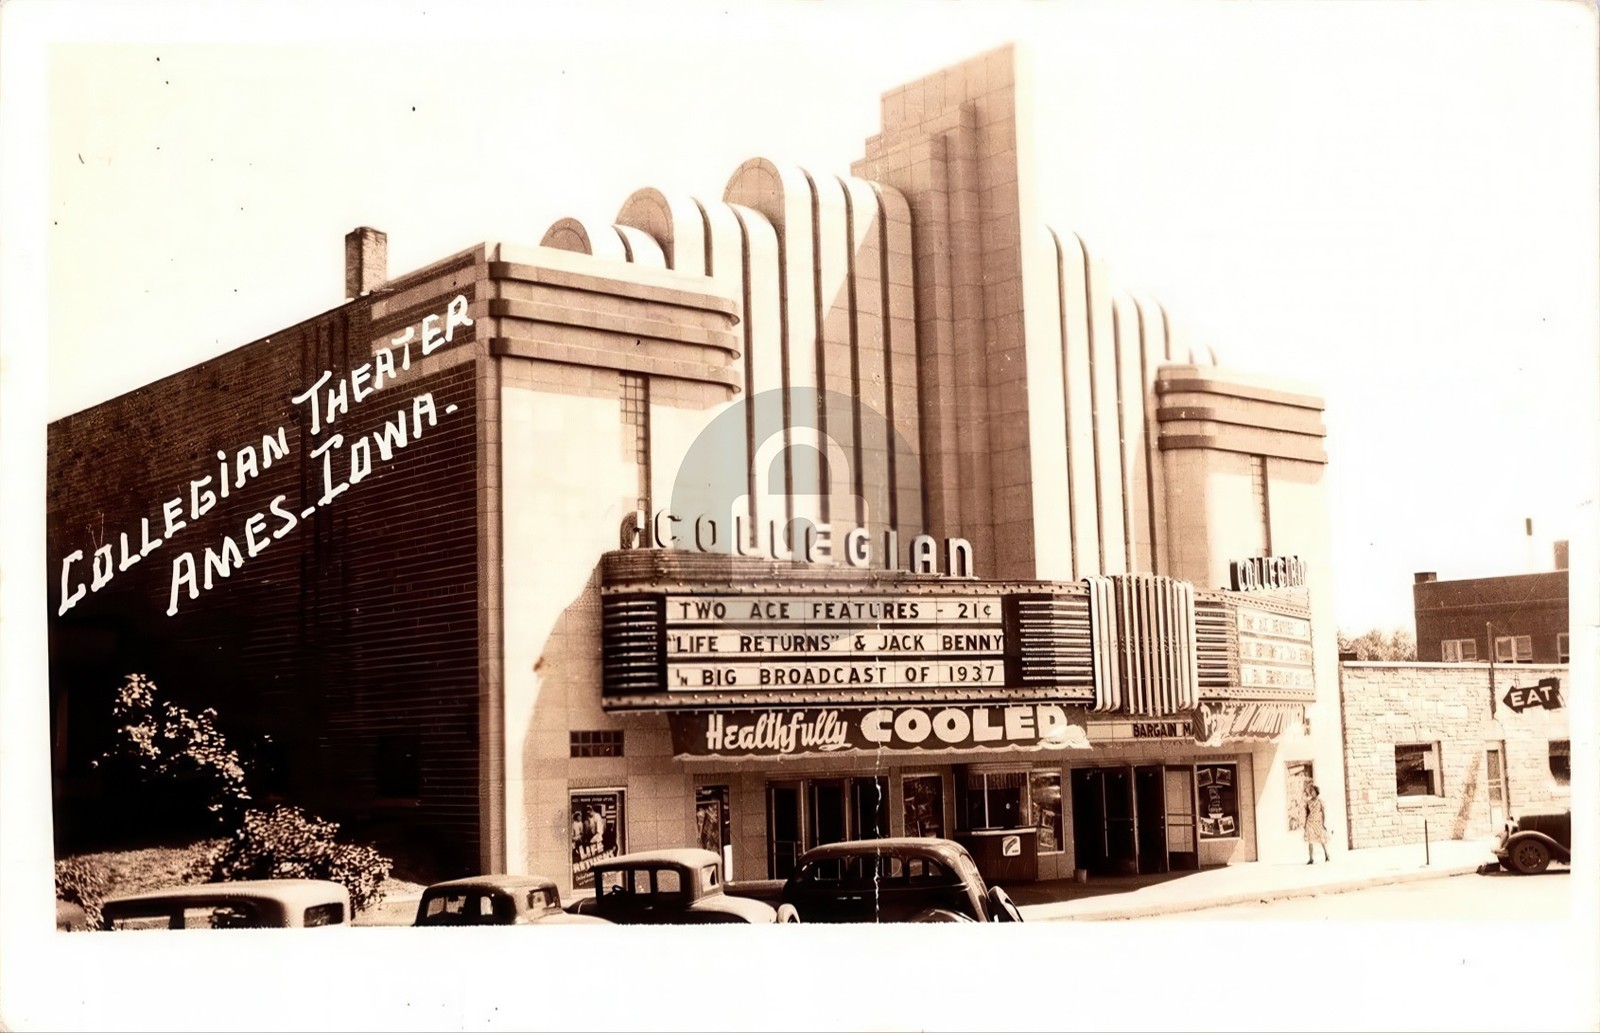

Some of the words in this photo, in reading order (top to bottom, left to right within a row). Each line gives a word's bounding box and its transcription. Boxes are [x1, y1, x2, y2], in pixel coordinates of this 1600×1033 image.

[654, 508, 975, 578] COLLEGIAN
[679, 601, 727, 620] TWO
[749, 601, 791, 619] ACE
[812, 602, 920, 620] FEATURES
[956, 602, 993, 619] 21¢
[853, 634, 867, 651] &
[877, 634, 926, 651] JACK
[941, 634, 1004, 651] BENNY
[701, 668, 738, 686] BIG
[759, 666, 888, 685] BROADCAST
[904, 666, 931, 683] OF
[948, 665, 996, 683] 1937
[1510, 685, 1554, 708] EAT
[705, 709, 852, 753] Healthfully
[859, 704, 1068, 743] COOLED
[1133, 722, 1177, 738] BARGAIN
